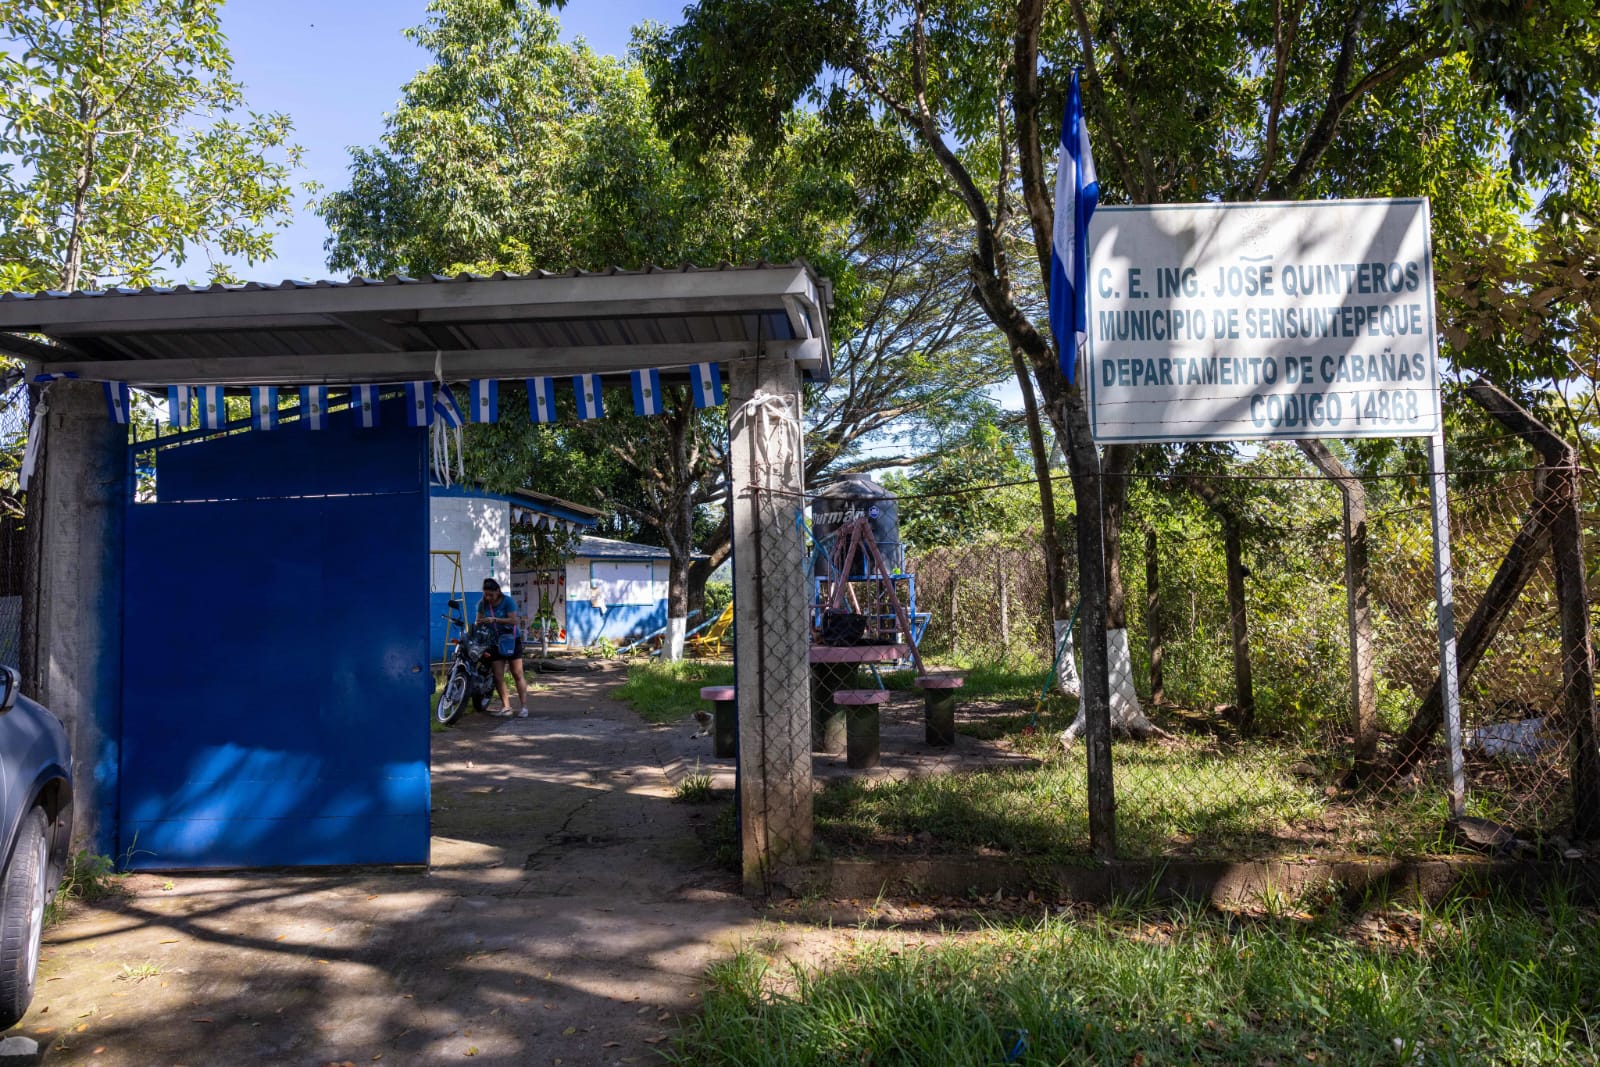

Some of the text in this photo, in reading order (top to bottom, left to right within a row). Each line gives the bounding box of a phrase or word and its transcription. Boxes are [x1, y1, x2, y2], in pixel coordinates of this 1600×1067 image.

[1097, 266, 1121, 299] C.
[1128, 267, 1150, 299] E.
[1157, 266, 1206, 299] ING.
[1281, 261, 1420, 299] QUINTEROS
[1099, 304, 1423, 342] MUNICIPIO DE SENSUNTEPEQUE
[1102, 347, 1426, 388] DEPARTAMENTO DE CABAÑAS
[1250, 389, 1419, 429] CODIGO 14868
